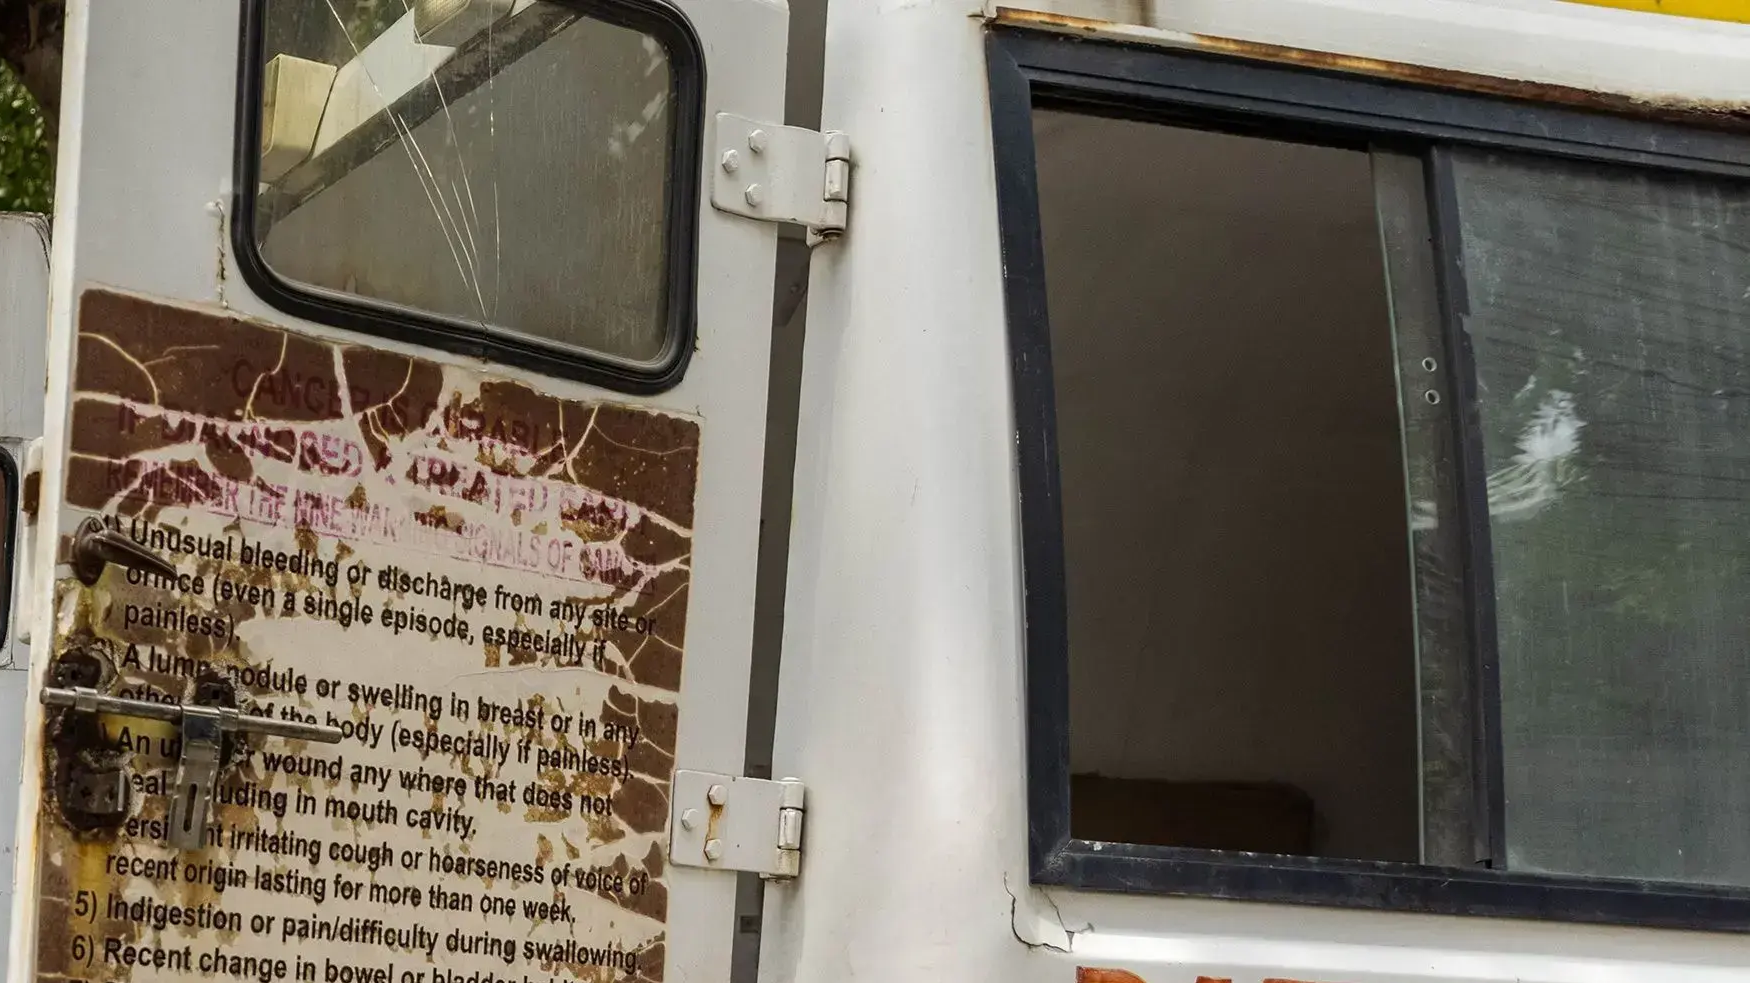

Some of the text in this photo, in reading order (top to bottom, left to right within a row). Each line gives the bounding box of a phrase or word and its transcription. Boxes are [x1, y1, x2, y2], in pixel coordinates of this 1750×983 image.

[131, 518, 629, 633] Unusual bleeding or discharge from any site
[125, 602, 241, 648] painless).
[212, 573, 587, 664] (even single episode, especially
[316, 678, 640, 749] or swelling breast any
[391, 720, 511, 766] (especially
[262, 749, 344, 781] wound
[351, 763, 392, 793] any
[399, 766, 468, 797] where
[474, 775, 516, 803] that
[522, 782, 573, 810] does
[580, 790, 614, 817] not
[296, 788, 478, 841] in mouth cavity.
[105, 854, 517, 917] recent origin lasting for more than one
[231, 829, 623, 892] irritating cough or hoarseness voice
[74, 890, 517, 964] 5) Indigestion or pain/difficulty during
[71, 935, 95, 969] 6)
[103, 937, 192, 971] Recent
[199, 947, 288, 983] change
[295, 955, 317, 982] in
